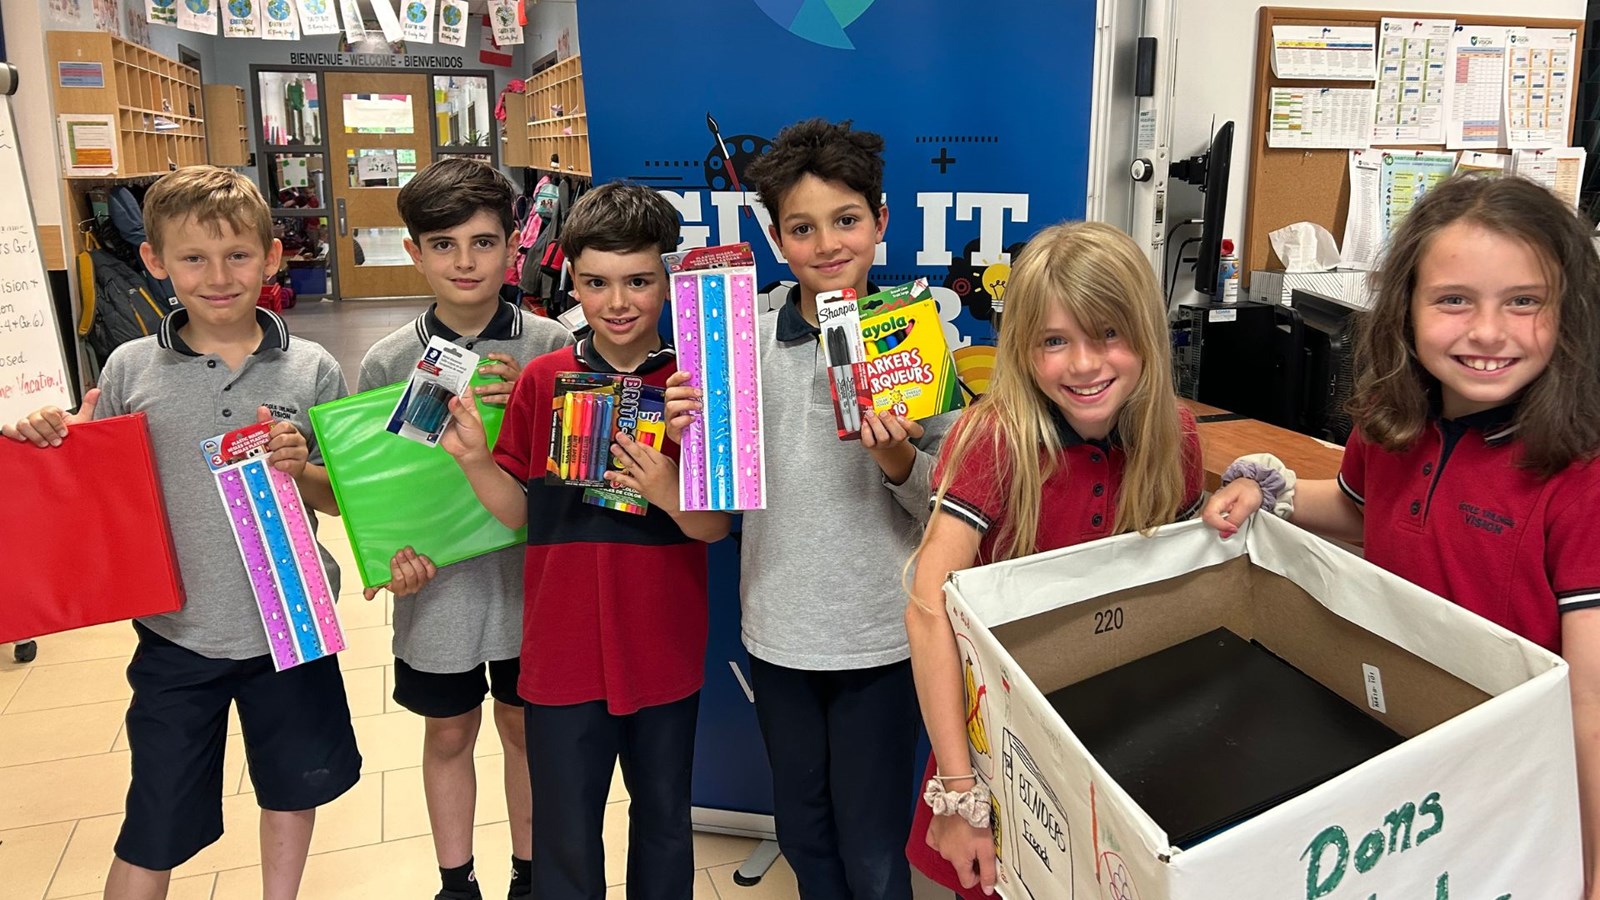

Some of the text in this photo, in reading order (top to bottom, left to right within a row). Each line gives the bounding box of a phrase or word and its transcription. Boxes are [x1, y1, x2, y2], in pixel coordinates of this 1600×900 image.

[290, 52, 343, 65] BIENVENUE
[349, 54, 396, 66] WELCOME
[404, 56, 463, 68] BIENVENIDOS
[916, 191, 1030, 266] IT
[819, 301, 857, 323] Sharpie
[620, 377, 641, 429] BRITE
[892, 403, 907, 416] 10
[213, 455, 223, 464] 3
[1094, 607, 1124, 635] 220
[1019, 773, 1066, 852] BINDERS
[1300, 792, 1444, 900] Dons
